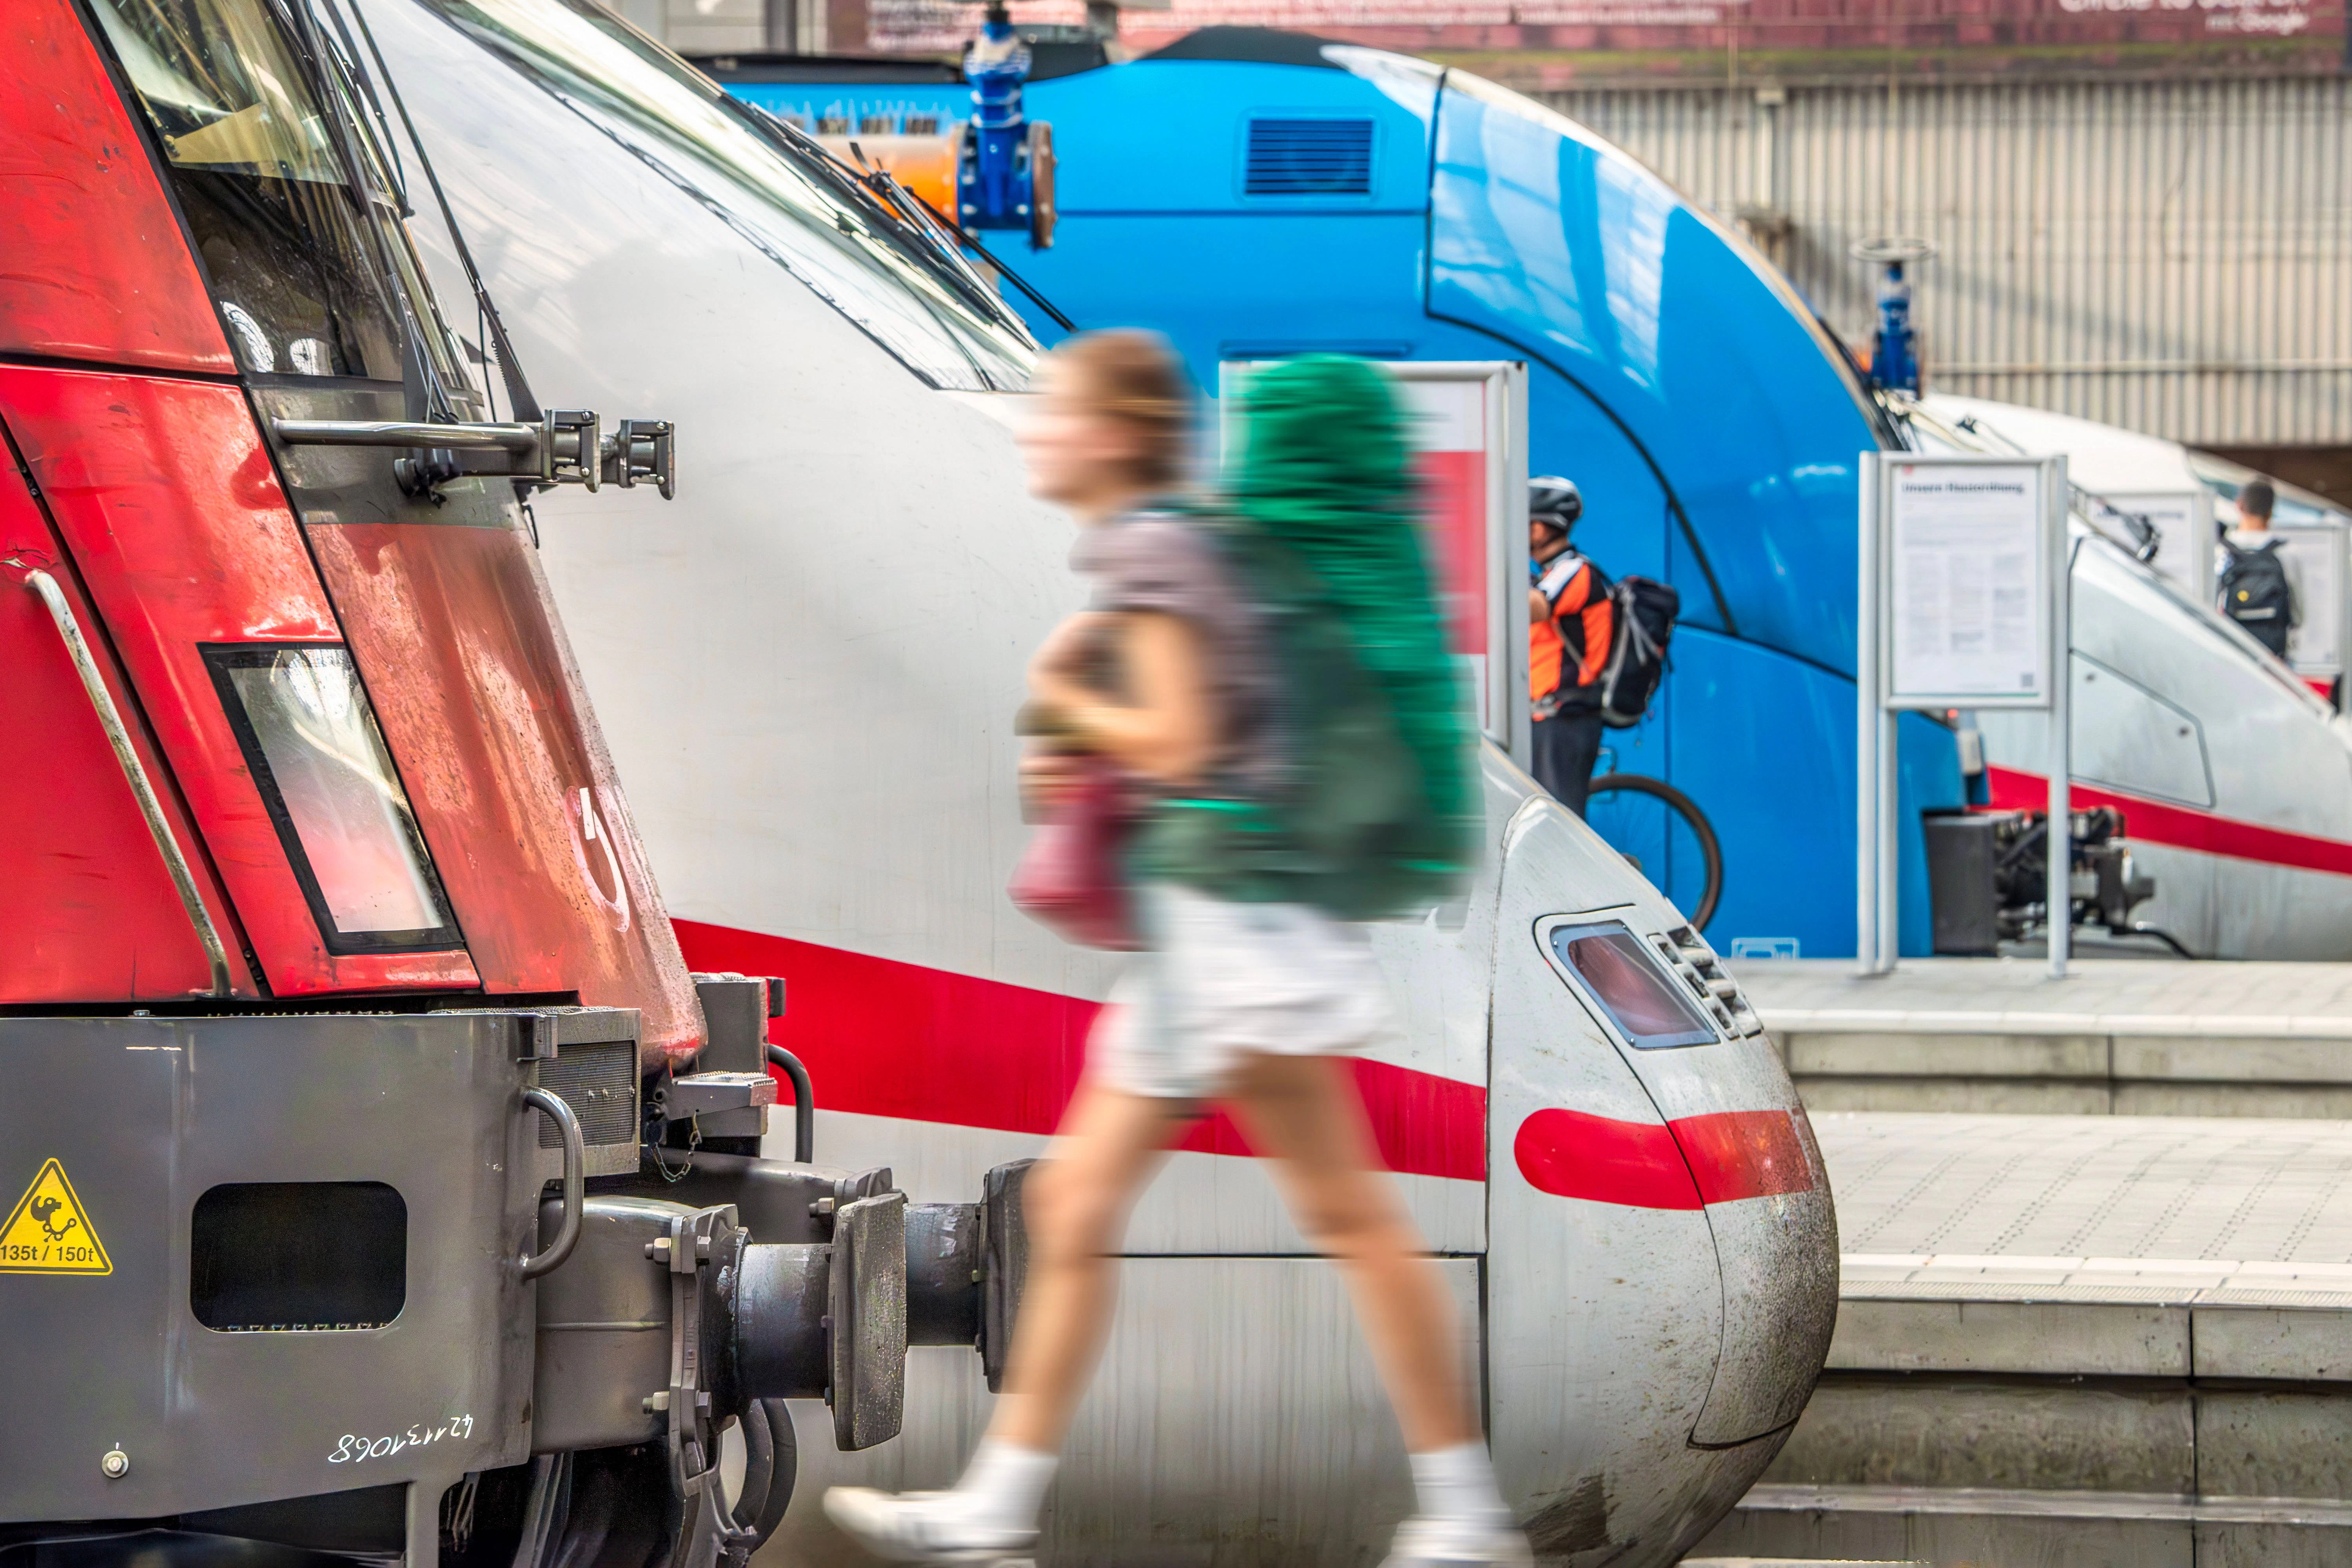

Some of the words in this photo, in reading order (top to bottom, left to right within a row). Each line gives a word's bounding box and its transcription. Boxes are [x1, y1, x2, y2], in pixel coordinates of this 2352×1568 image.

[0, 1245, 38, 1260] 135t
[42, 1245, 49, 1261] /
[56, 1247, 94, 1261] 150t
